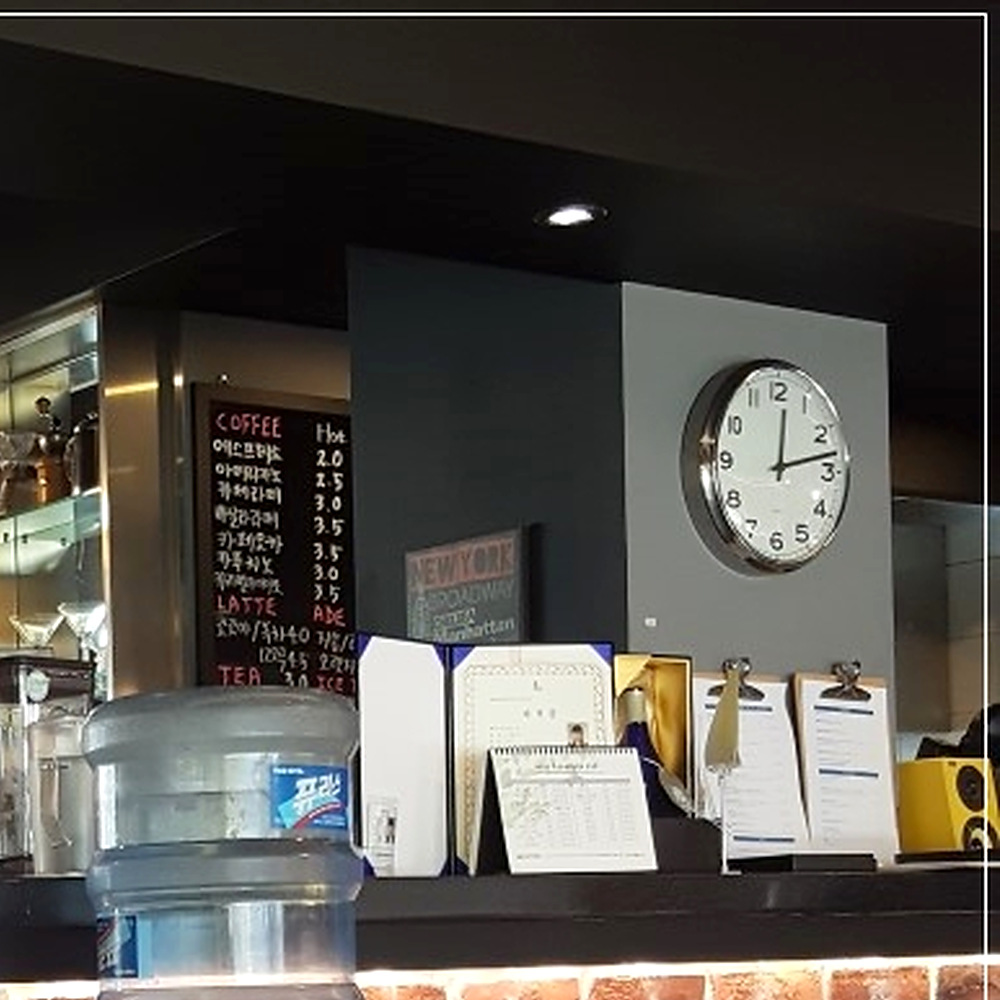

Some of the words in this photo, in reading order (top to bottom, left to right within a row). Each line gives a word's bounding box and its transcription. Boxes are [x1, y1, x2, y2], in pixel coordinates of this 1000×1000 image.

[748, 387, 760, 408] 11
[769, 382, 788, 402] 12
[216, 412, 282, 438] COFFEE
[316, 422, 347, 444] Hot
[728, 415, 743, 436] 10
[813, 425, 829, 444] 2
[316, 449, 344, 468] 2.0
[719, 451, 734, 470] 9
[820, 462, 836, 482] 3
[314, 493, 342, 514] 3.0
[725, 490, 742, 509] 8
[813, 499, 827, 518] 4
[314, 516, 345, 537] 3.5
[745, 519, 758, 539] 7
[794, 524, 810, 543] 5
[769, 532, 784, 551] 6
[313, 542, 344, 563] 3.5
[313, 563, 340, 581] 3.0
[314, 583, 342, 604] 3.5
[217, 594, 277, 617] LATTE
[313, 604, 346, 627] ADE
[218, 665, 262, 687] TEA
